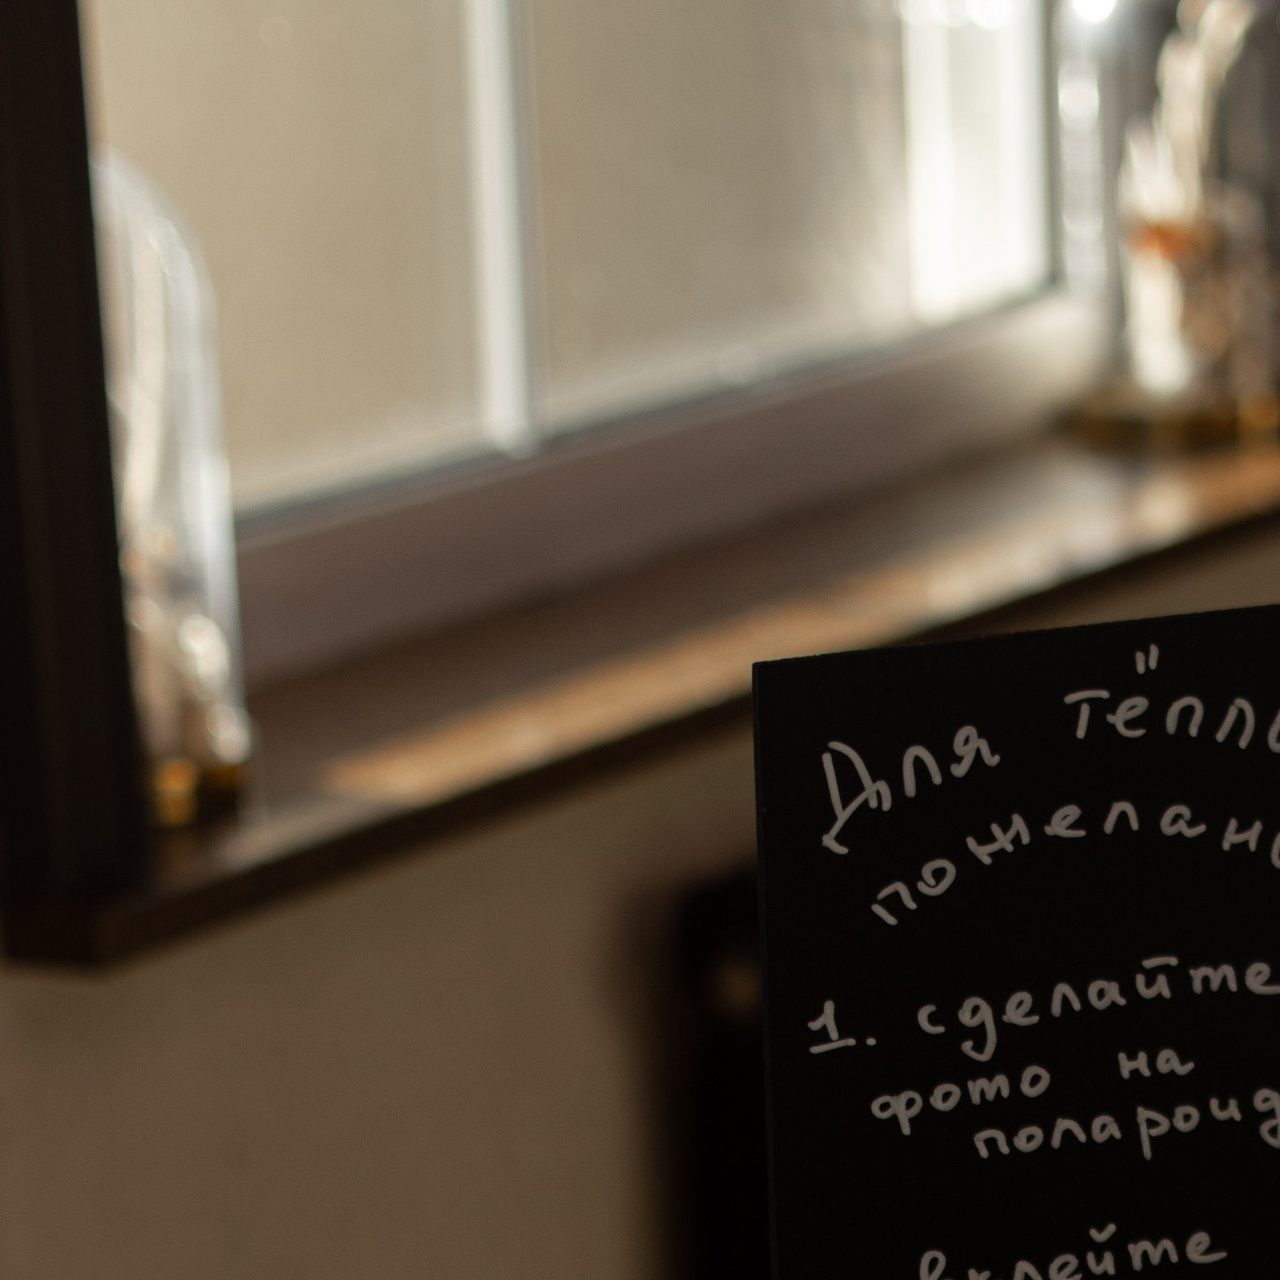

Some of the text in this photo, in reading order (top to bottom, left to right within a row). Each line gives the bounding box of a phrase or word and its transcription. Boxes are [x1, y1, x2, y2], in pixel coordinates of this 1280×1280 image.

[822, 726, 999, 854] Для
[808, 1001, 876, 1053] 1.
[871, 1049, 1194, 1135] фото на
